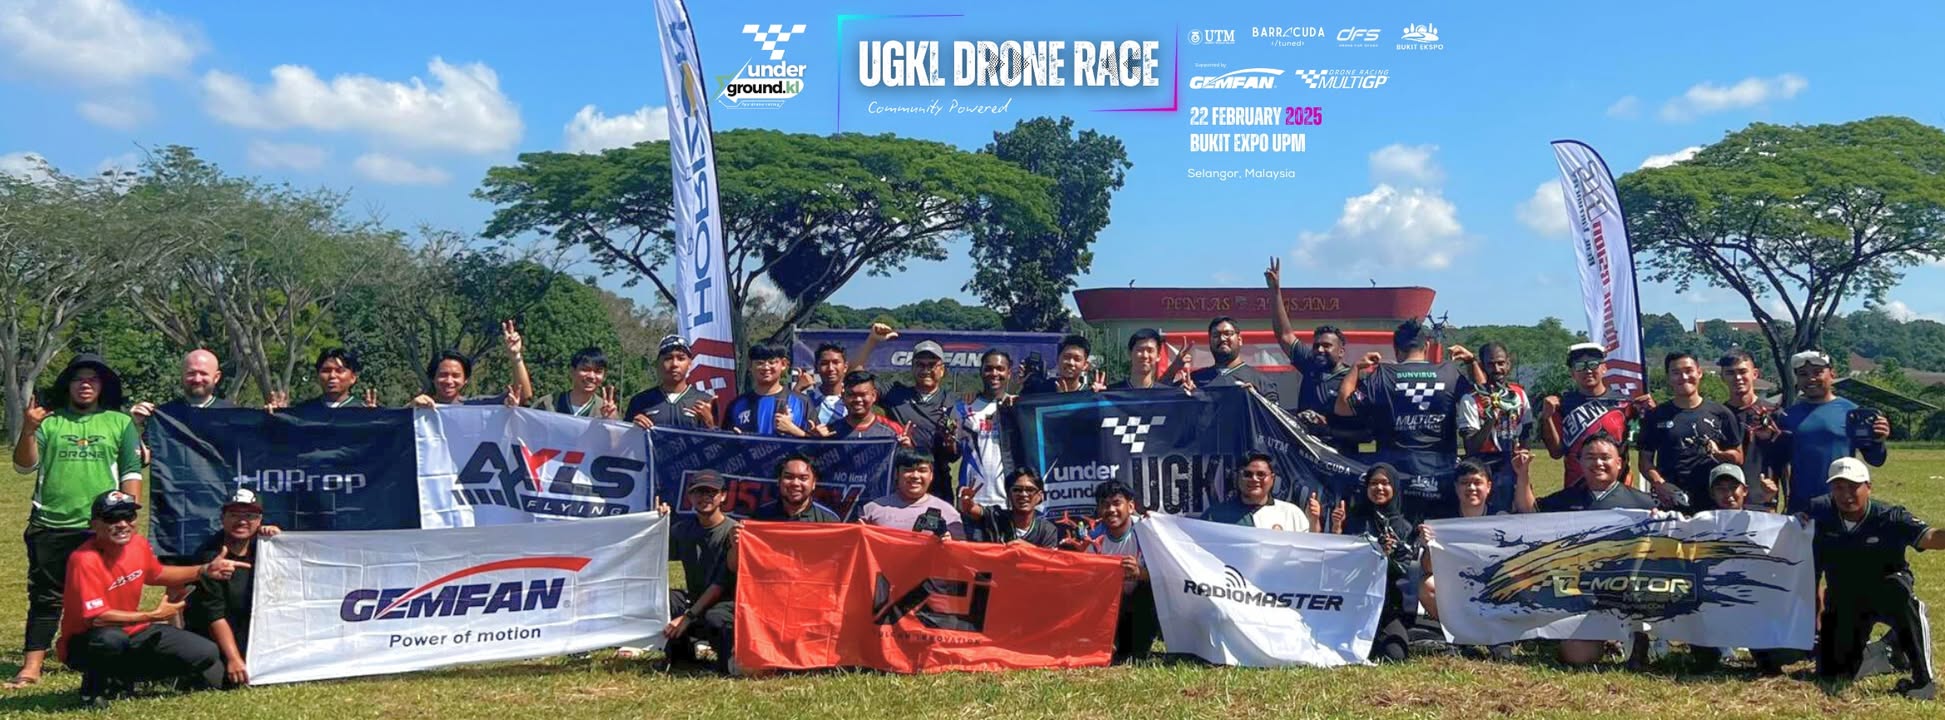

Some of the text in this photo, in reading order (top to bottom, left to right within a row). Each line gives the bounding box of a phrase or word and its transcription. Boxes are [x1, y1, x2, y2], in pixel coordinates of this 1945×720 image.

[59, 450, 105, 459] DRONE
[1054, 462, 1119, 481] under
[526, 500, 624, 516] FLYING
[340, 577, 565, 622] GEMFAN
[389, 627, 541, 648] Power of motion
